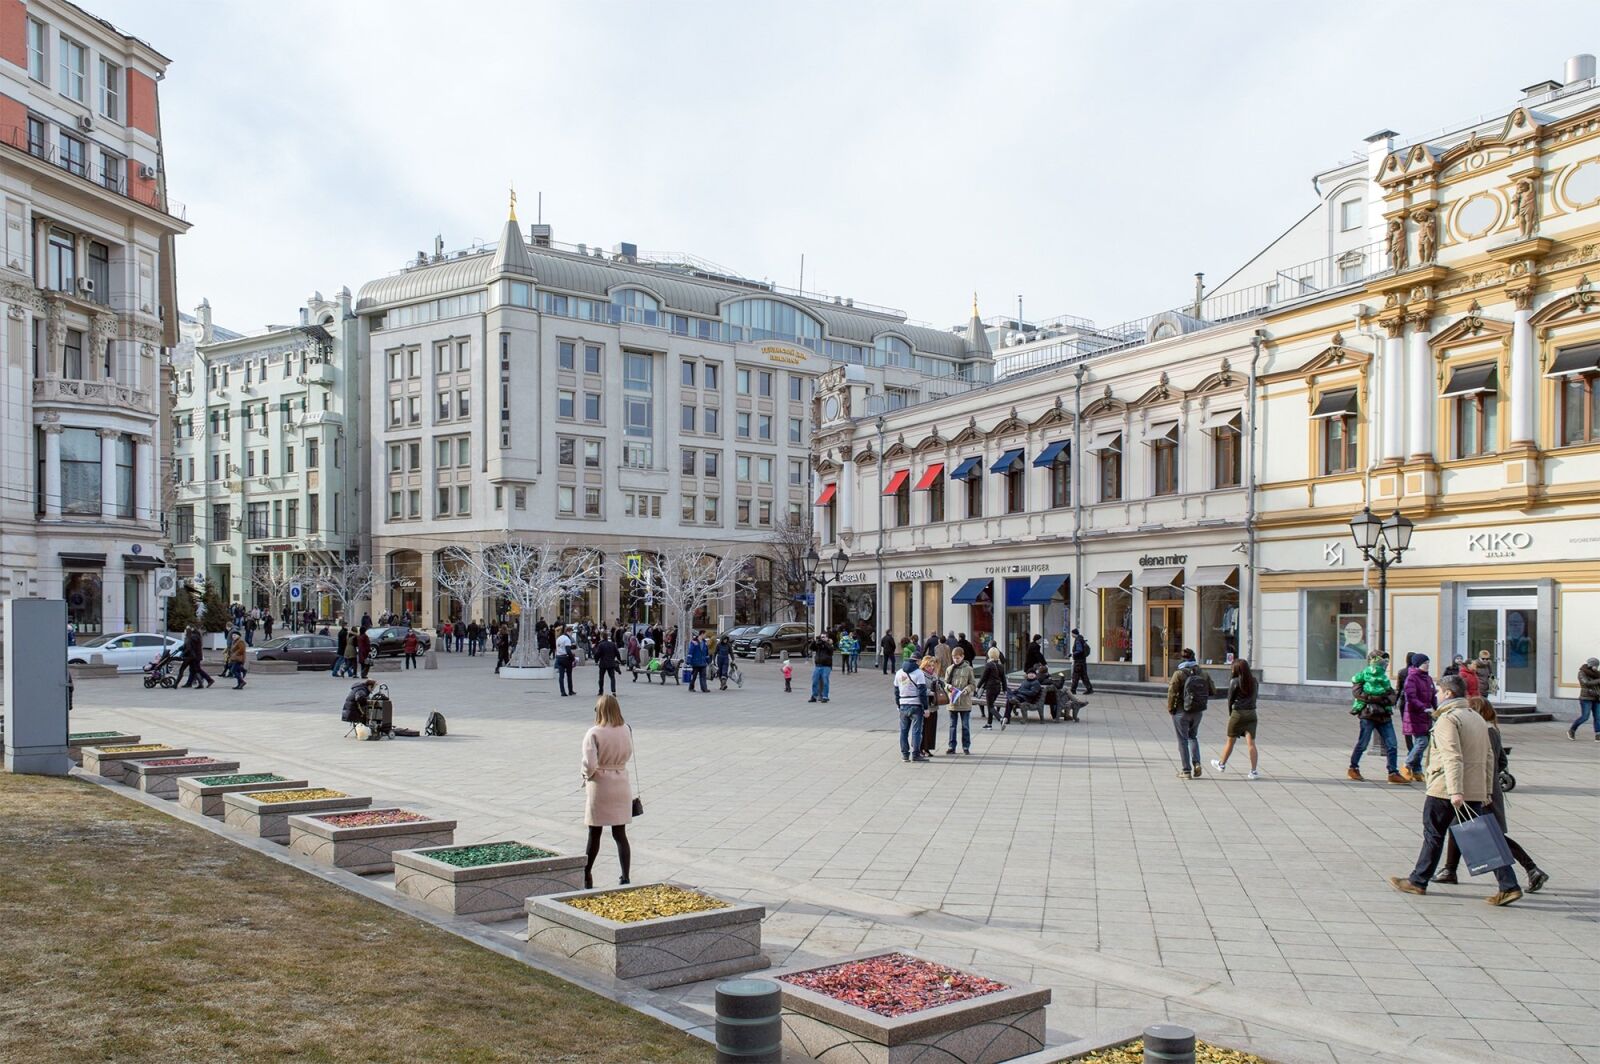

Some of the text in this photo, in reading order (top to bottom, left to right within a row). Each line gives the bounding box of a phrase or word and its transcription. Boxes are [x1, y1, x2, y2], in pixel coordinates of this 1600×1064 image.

[1466, 531, 1534, 551] KIKO
[1139, 554, 1164, 566] elena
[902, 569, 924, 579] OMEGA
[985, 564, 1050, 574] TOMMY HILFIGER
[839, 572, 859, 582] OMEGA
